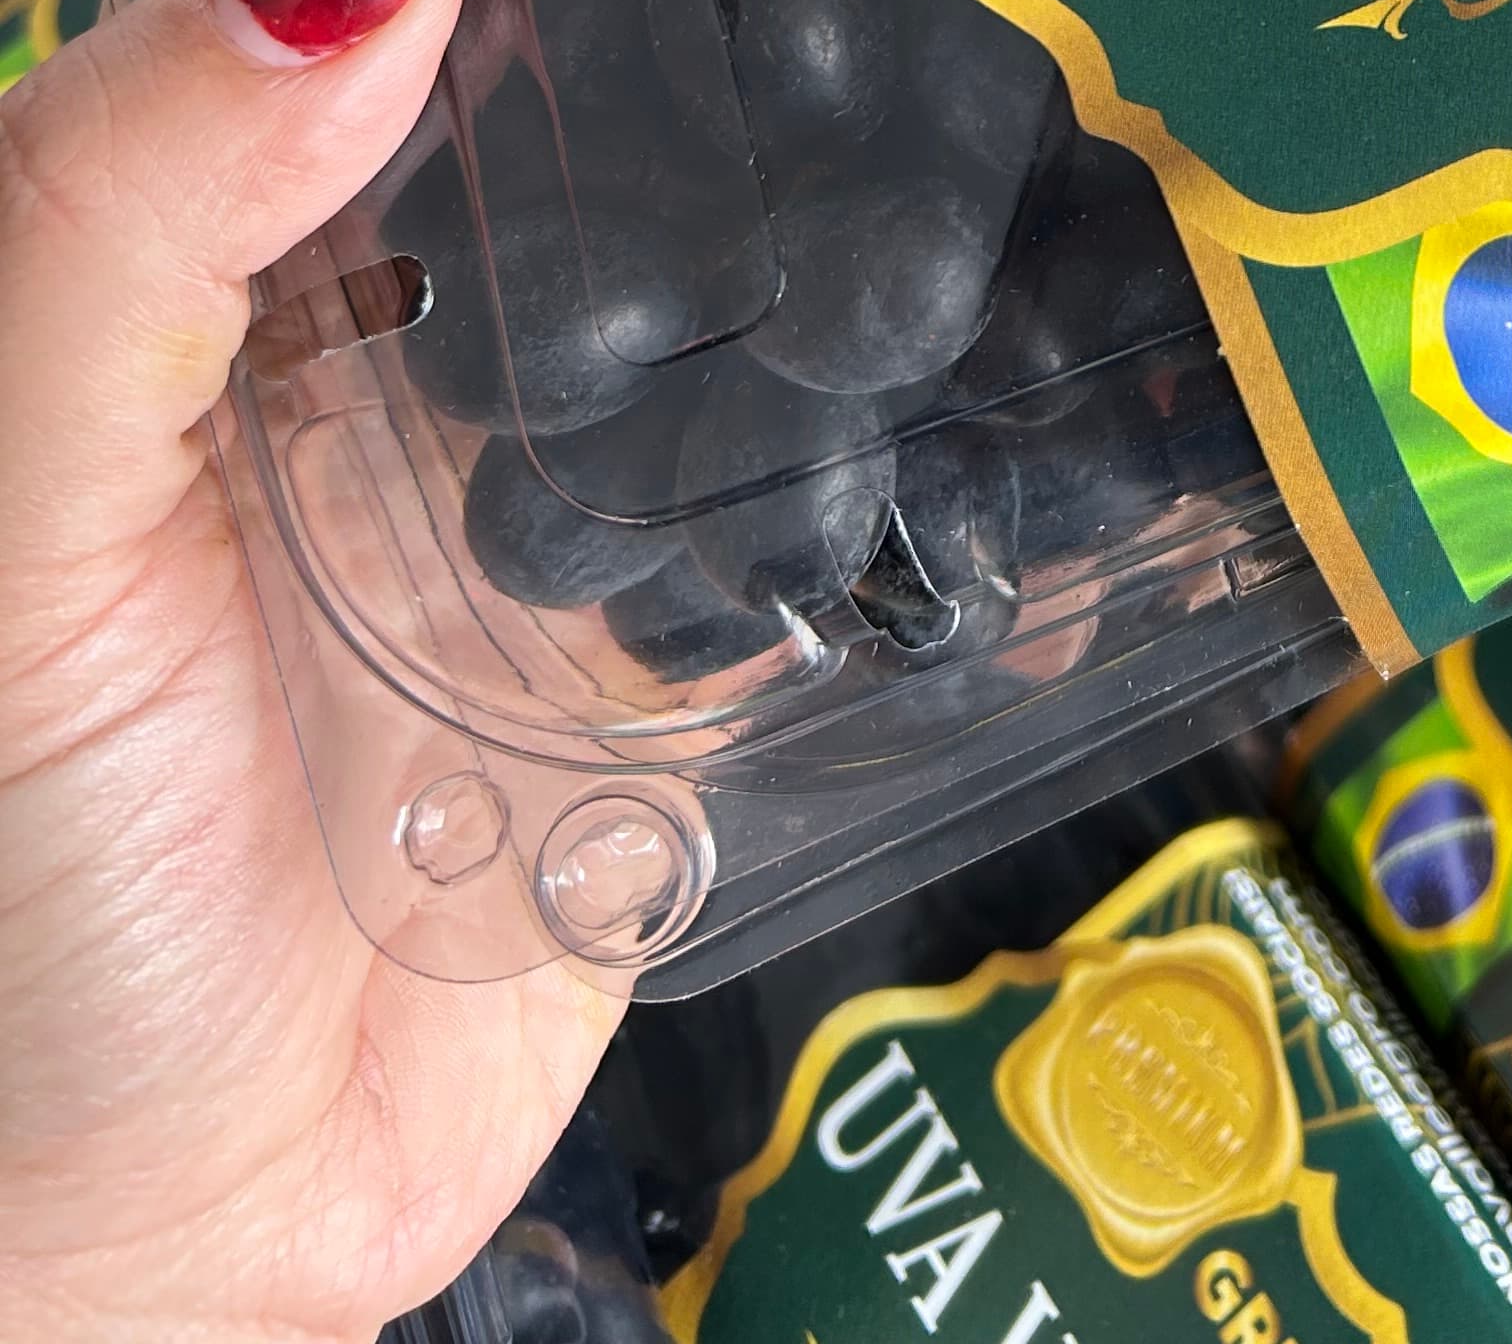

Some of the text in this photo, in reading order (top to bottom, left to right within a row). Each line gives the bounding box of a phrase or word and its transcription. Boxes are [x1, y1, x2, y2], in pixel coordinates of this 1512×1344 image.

[1327, 1018, 1424, 1149] REDES
[816, 1039, 1004, 1336] UVA
[1194, 1249, 1302, 1344] GR
